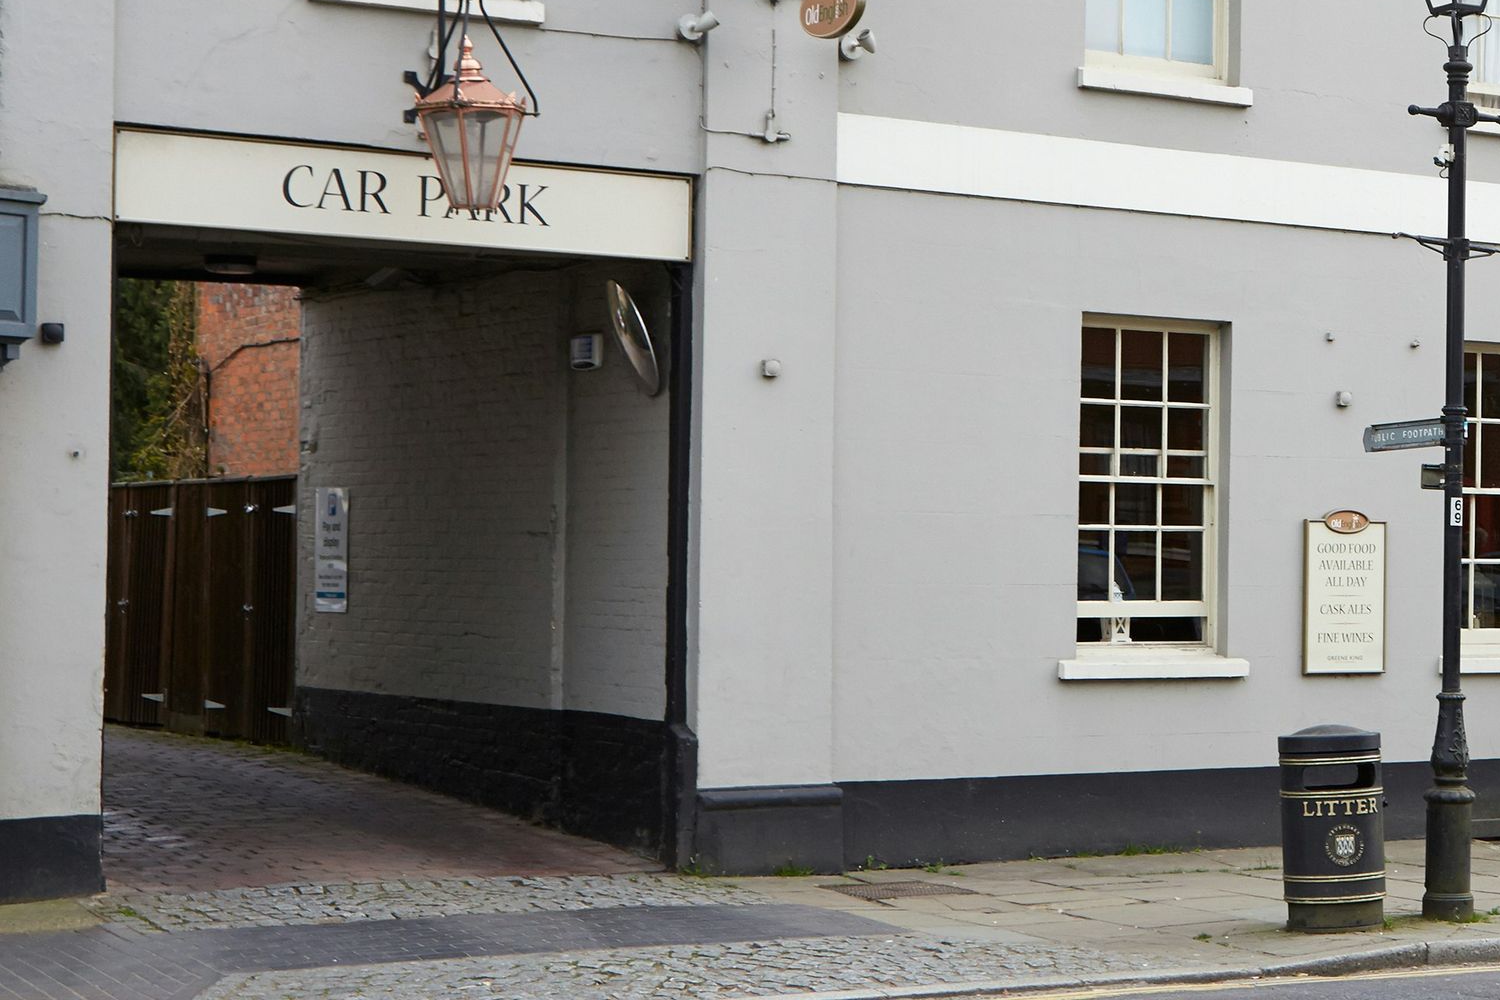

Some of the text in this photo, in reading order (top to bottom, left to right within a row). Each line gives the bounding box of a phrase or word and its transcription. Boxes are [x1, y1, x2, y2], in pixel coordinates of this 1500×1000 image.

[282, 164, 392, 215] CAR
[1371, 427, 1444, 443] BLIC FOOTPATH
[1317, 543, 1377, 554] GOOD FOOD
[1318, 560, 1374, 571] AVAILABLE
[1325, 576, 1368, 587] ALL DAY
[1319, 604, 1372, 615] CASK ALES
[1317, 632, 1374, 644] FINE WINES
[1303, 797, 1379, 817] LITTER
